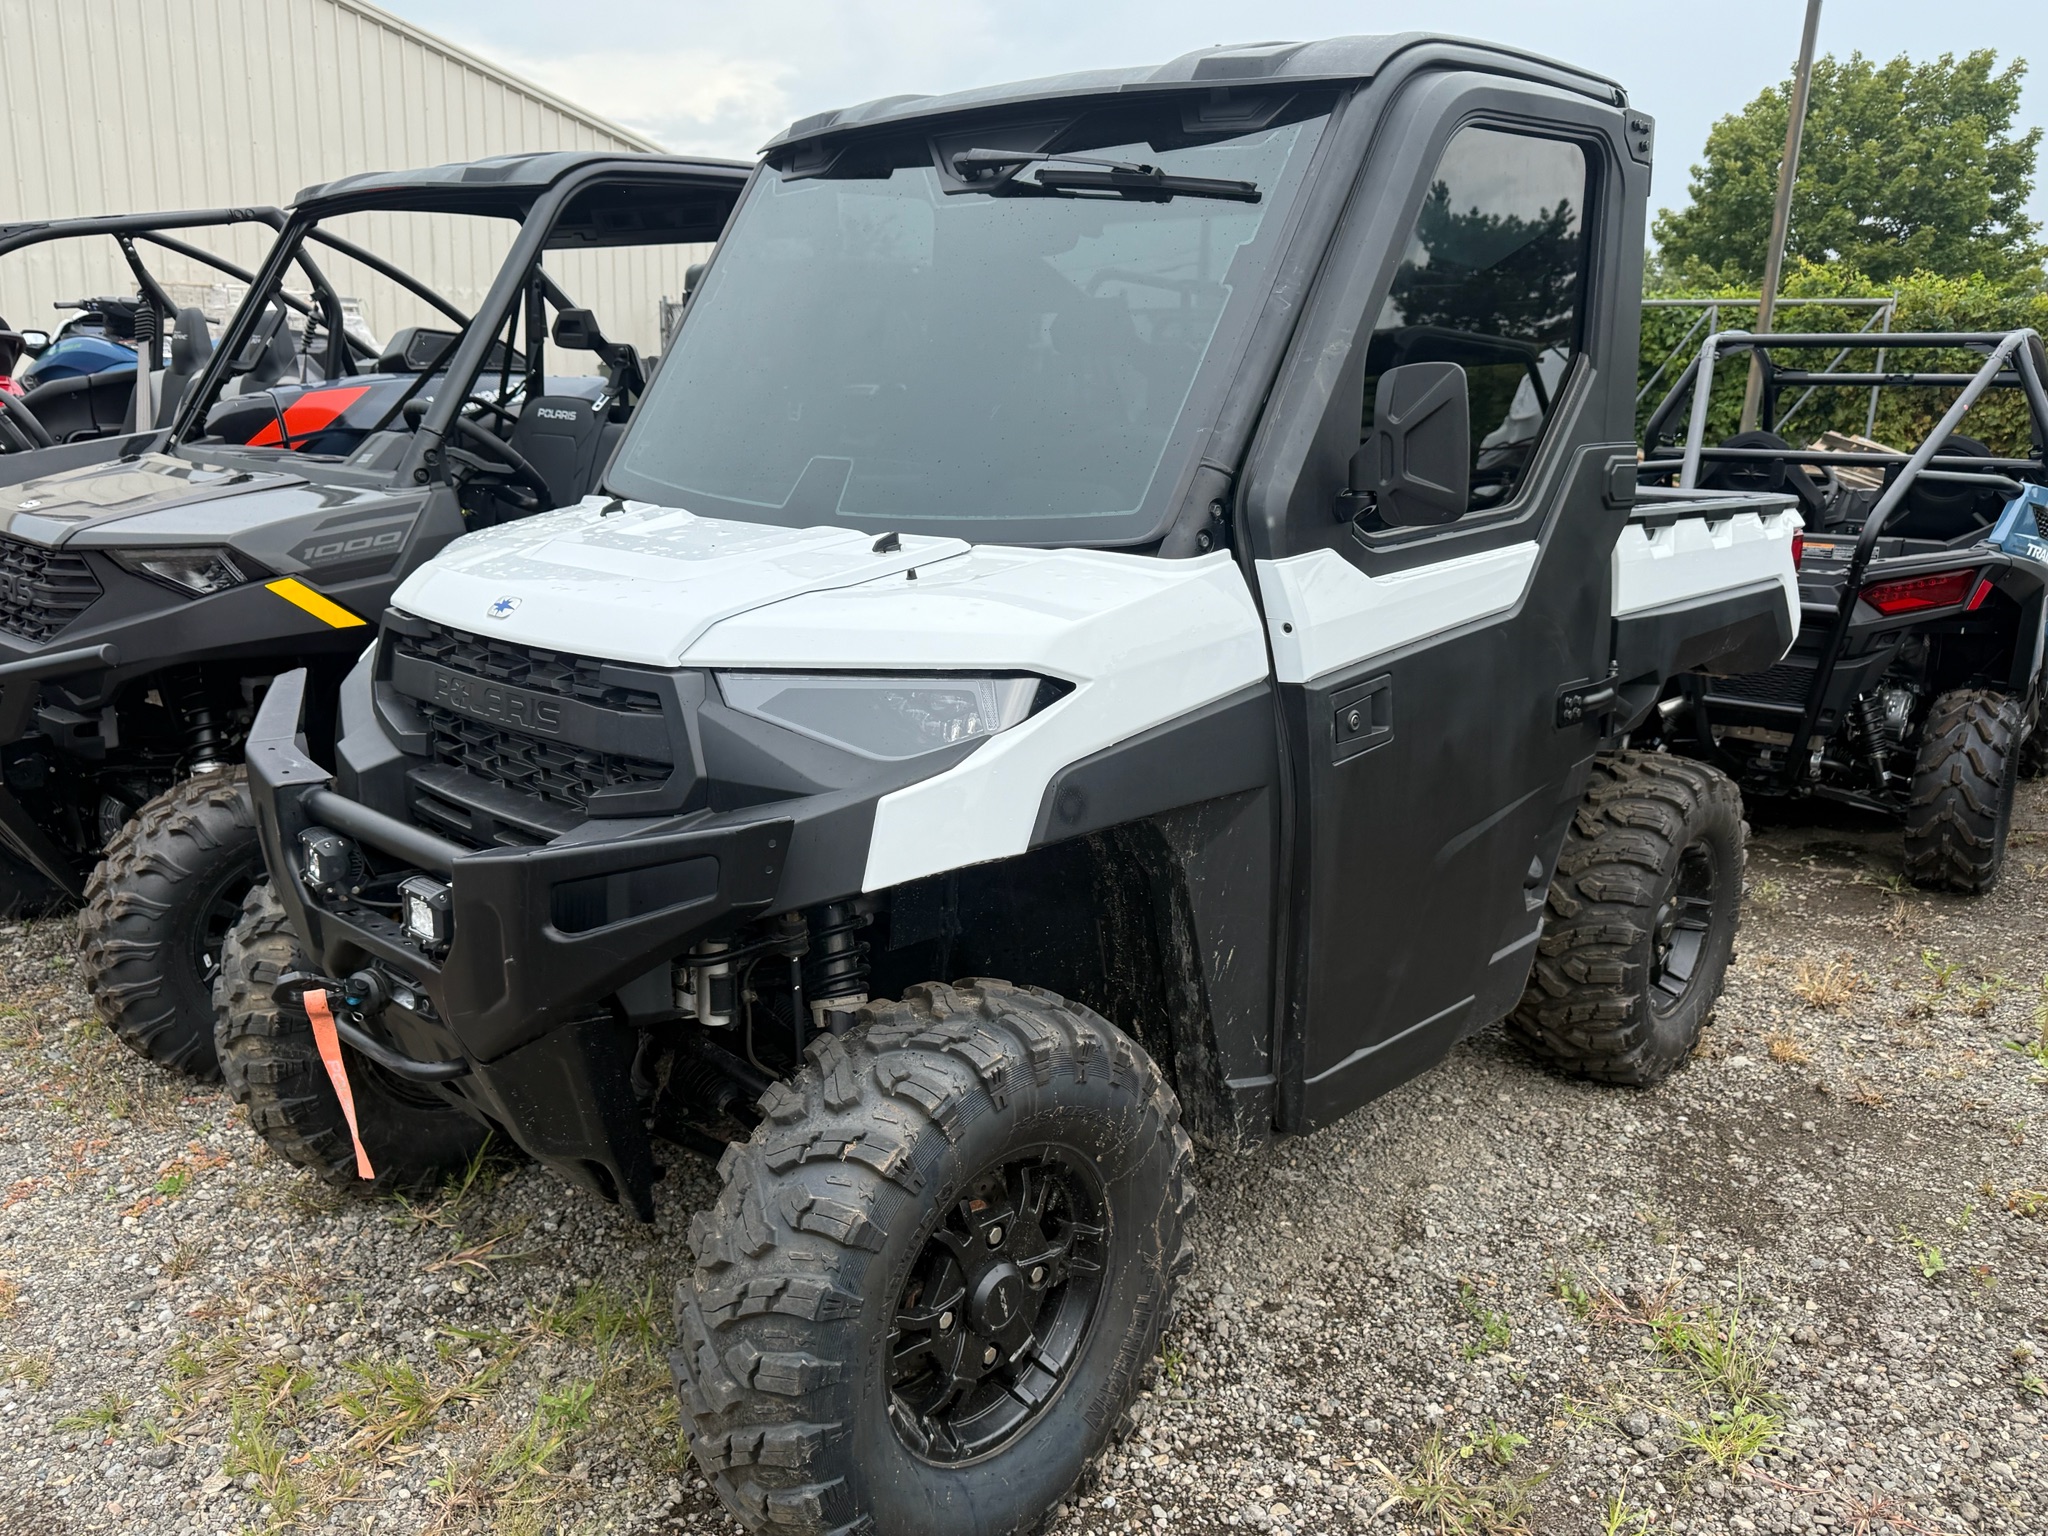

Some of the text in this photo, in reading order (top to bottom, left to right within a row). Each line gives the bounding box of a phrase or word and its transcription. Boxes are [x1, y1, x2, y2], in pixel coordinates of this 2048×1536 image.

[537, 408, 577, 421] POLARIS
[303, 531, 402, 560] 1000
[434, 671, 560, 734] POLARIS
